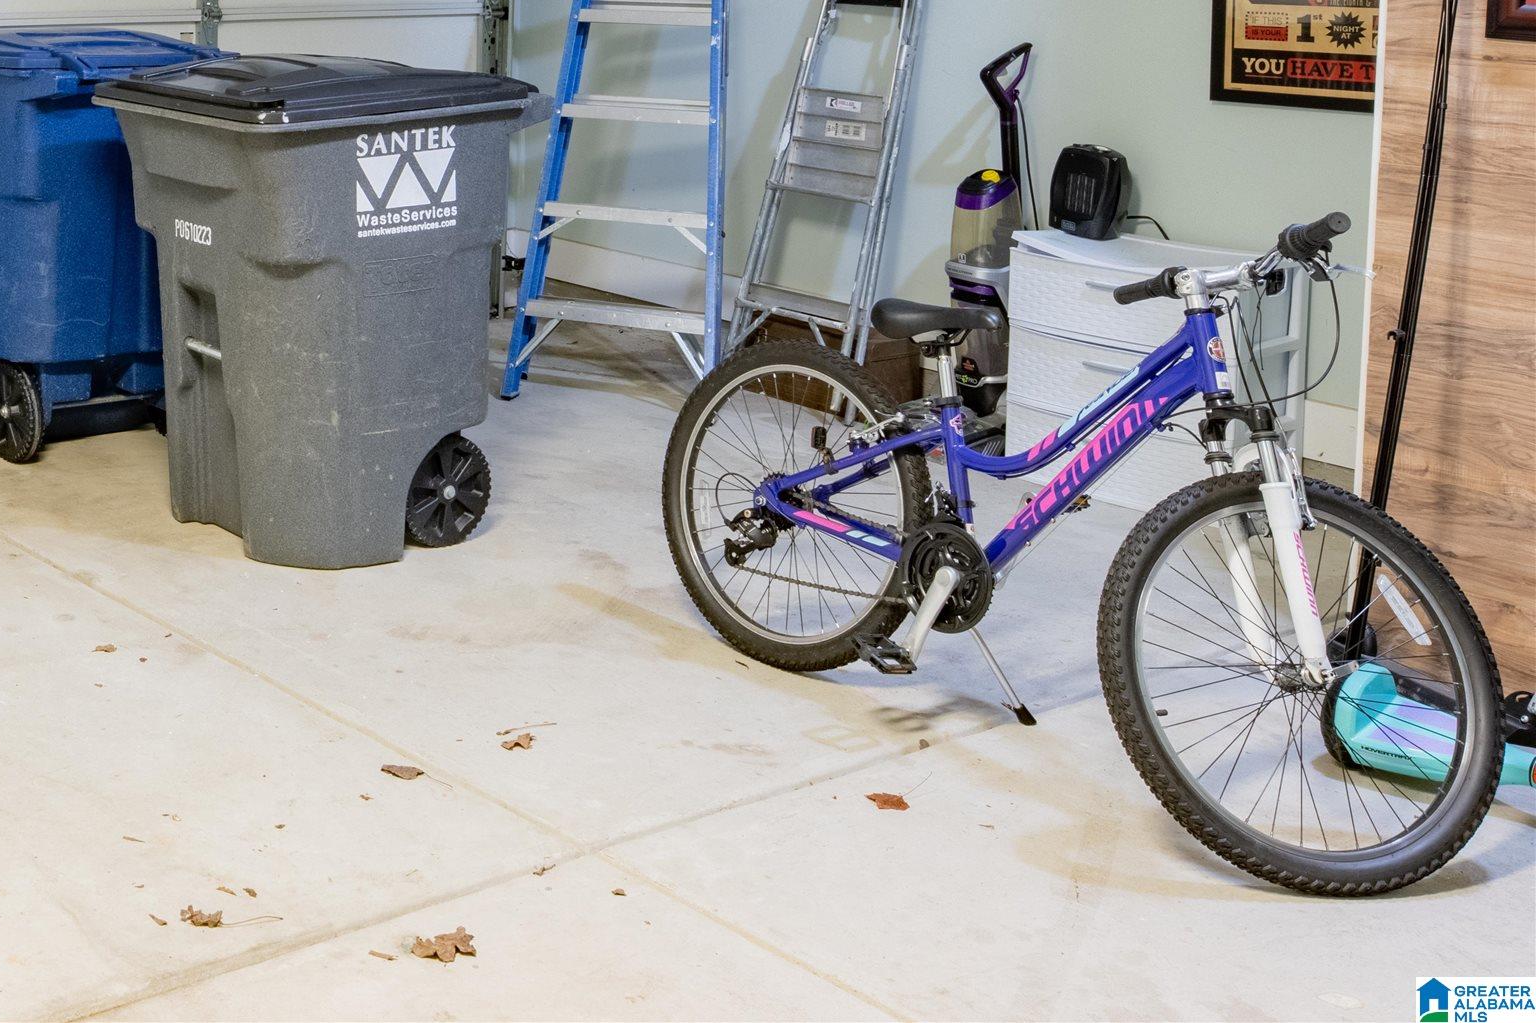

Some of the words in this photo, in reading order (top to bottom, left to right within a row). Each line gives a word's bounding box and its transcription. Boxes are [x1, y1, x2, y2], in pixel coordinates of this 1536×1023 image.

[1263, 16, 1283, 26] THIS
[1333, 25, 1360, 33] NIGHT
[1242, 57, 1285, 75] YOU
[1290, 59, 1354, 80] HAVE
[356, 125, 456, 157] SANTEK
[356, 206, 458, 228] WasteServices
[357, 219, 457, 238] santekwasteservices.com
